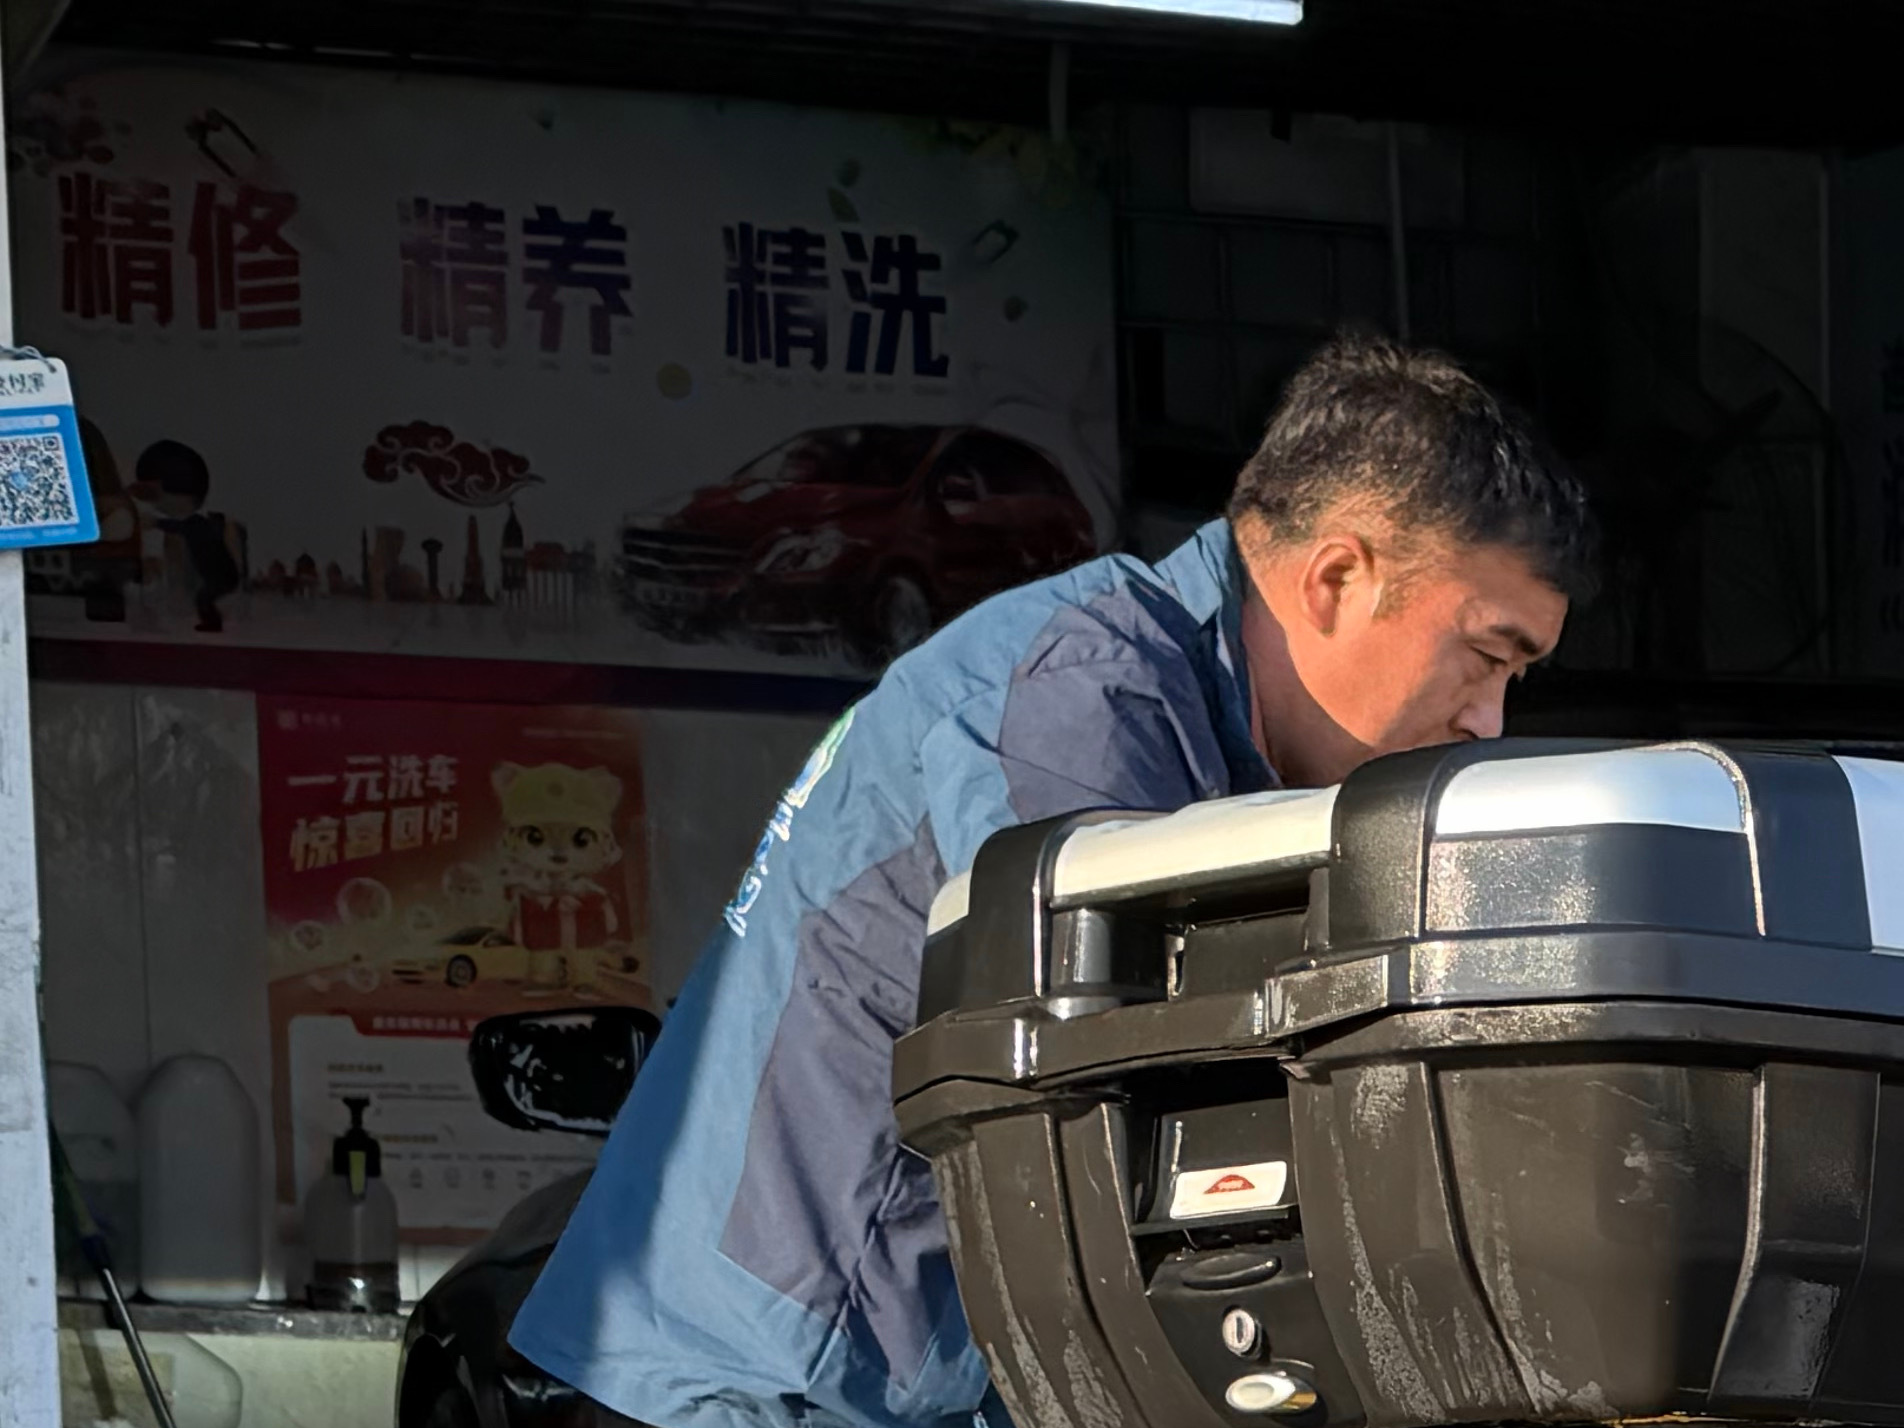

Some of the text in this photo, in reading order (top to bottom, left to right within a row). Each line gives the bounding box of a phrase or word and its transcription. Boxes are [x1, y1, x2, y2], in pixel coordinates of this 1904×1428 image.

[58, 172, 950, 379] 精修 精养 精洗
[286, 754, 459, 805] 一元洗车
[289, 801, 459, 872] 惊喜回归
